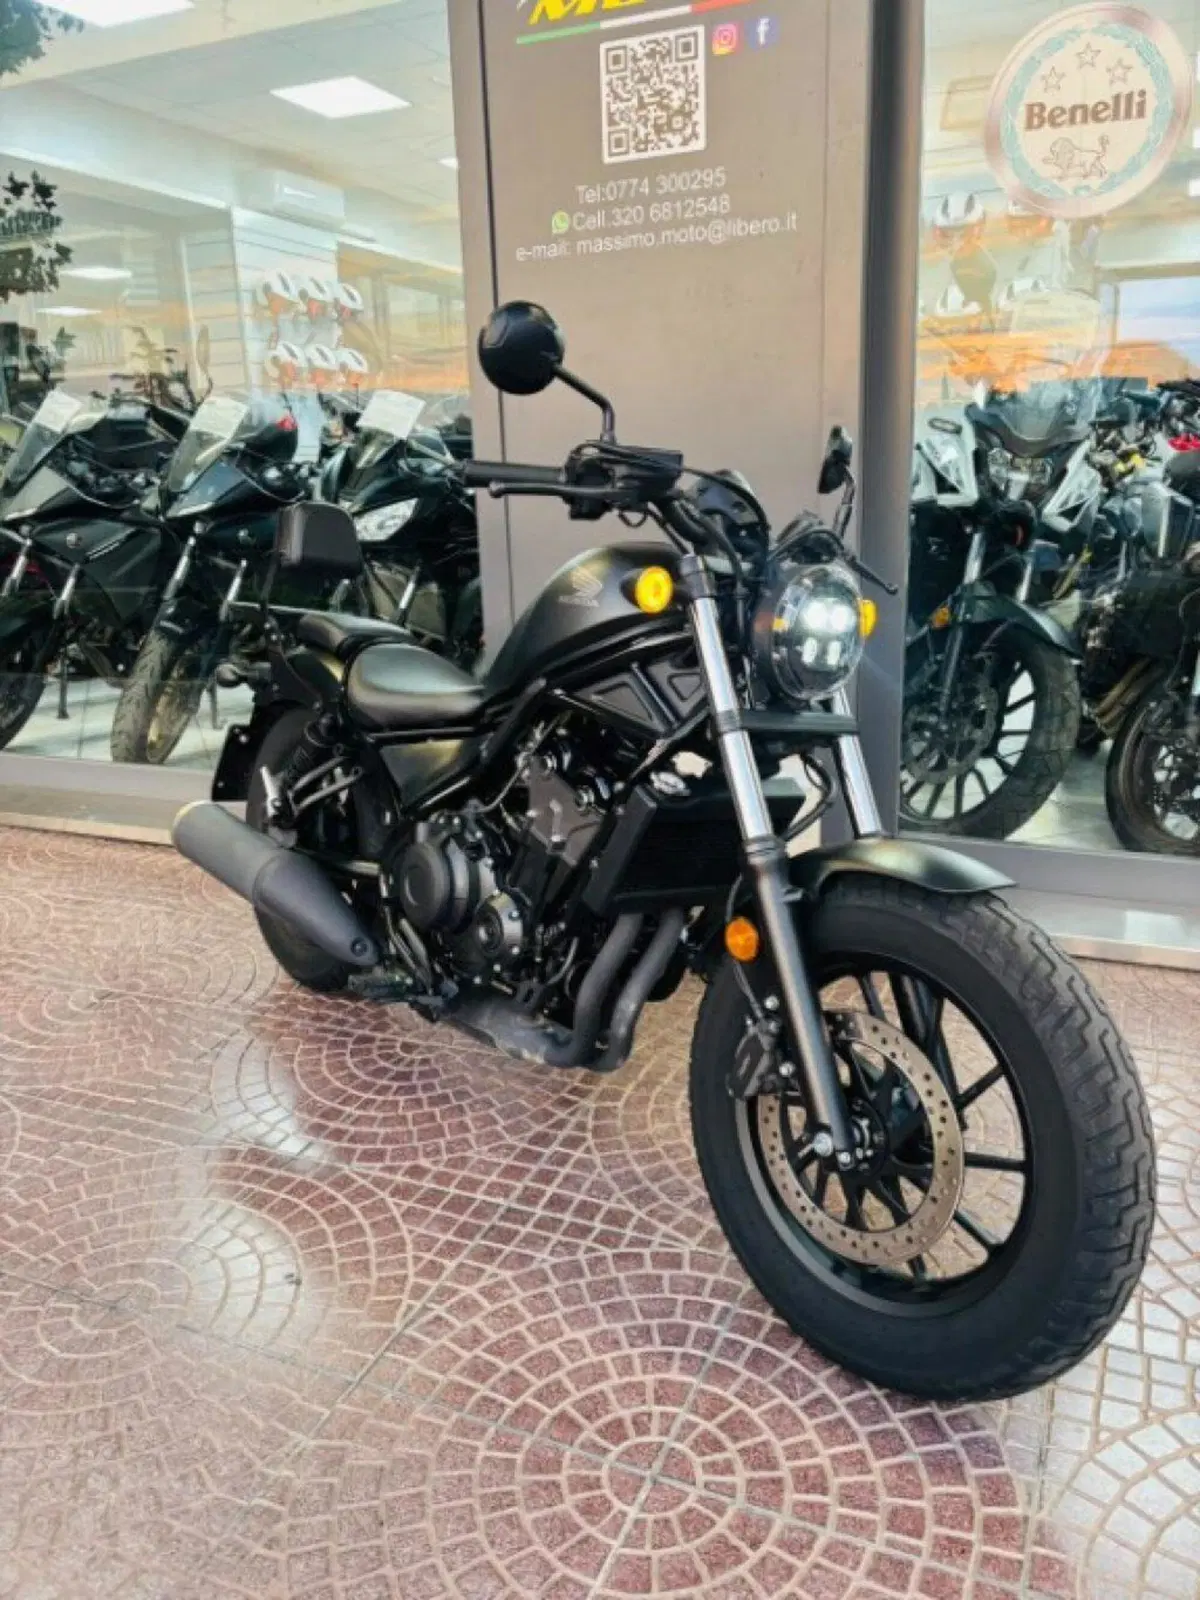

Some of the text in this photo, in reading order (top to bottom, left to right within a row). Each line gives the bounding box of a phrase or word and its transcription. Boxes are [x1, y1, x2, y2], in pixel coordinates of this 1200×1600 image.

[1024, 88, 1147, 132] Benelli
[576, 166, 726, 205] Tel:0774 300295
[649, 193, 730, 222] 6812548
